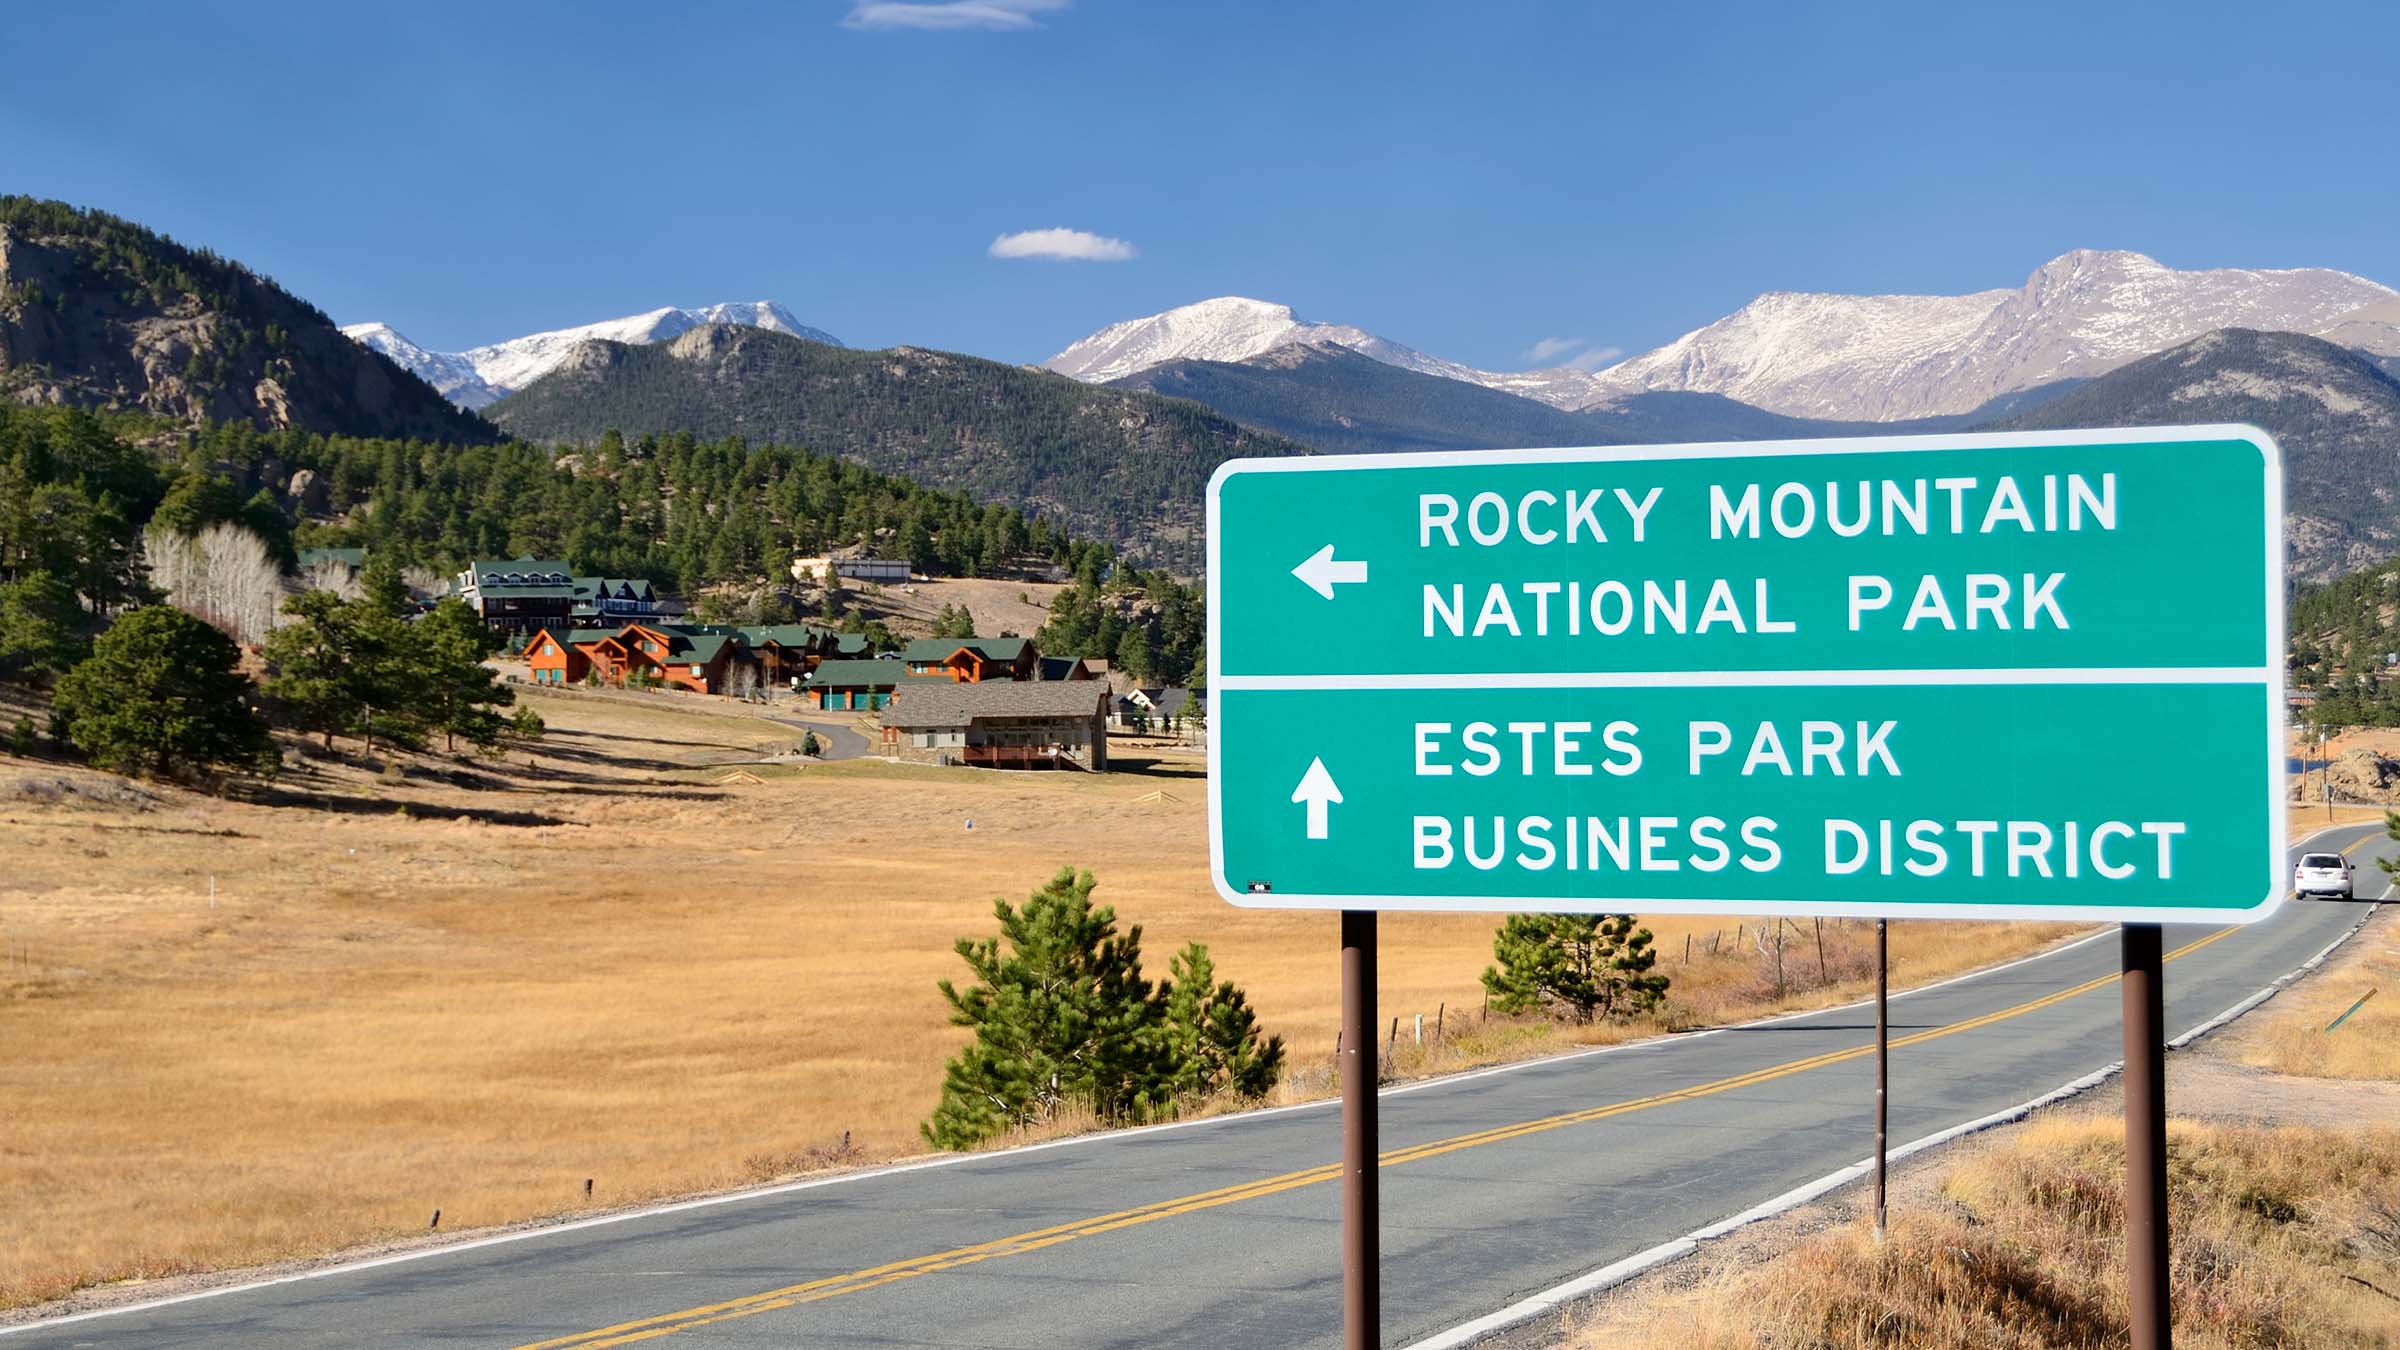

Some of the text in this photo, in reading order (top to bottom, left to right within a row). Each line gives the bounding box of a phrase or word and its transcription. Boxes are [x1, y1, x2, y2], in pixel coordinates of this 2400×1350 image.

[1419, 473, 2116, 547] ROCKY MOUNTAIN
[1423, 572, 2069, 637] NATIONAL PARK
[1415, 720, 1901, 776] ESTES PARK
[1413, 815, 2186, 879] BUSINESS DISTRICT
